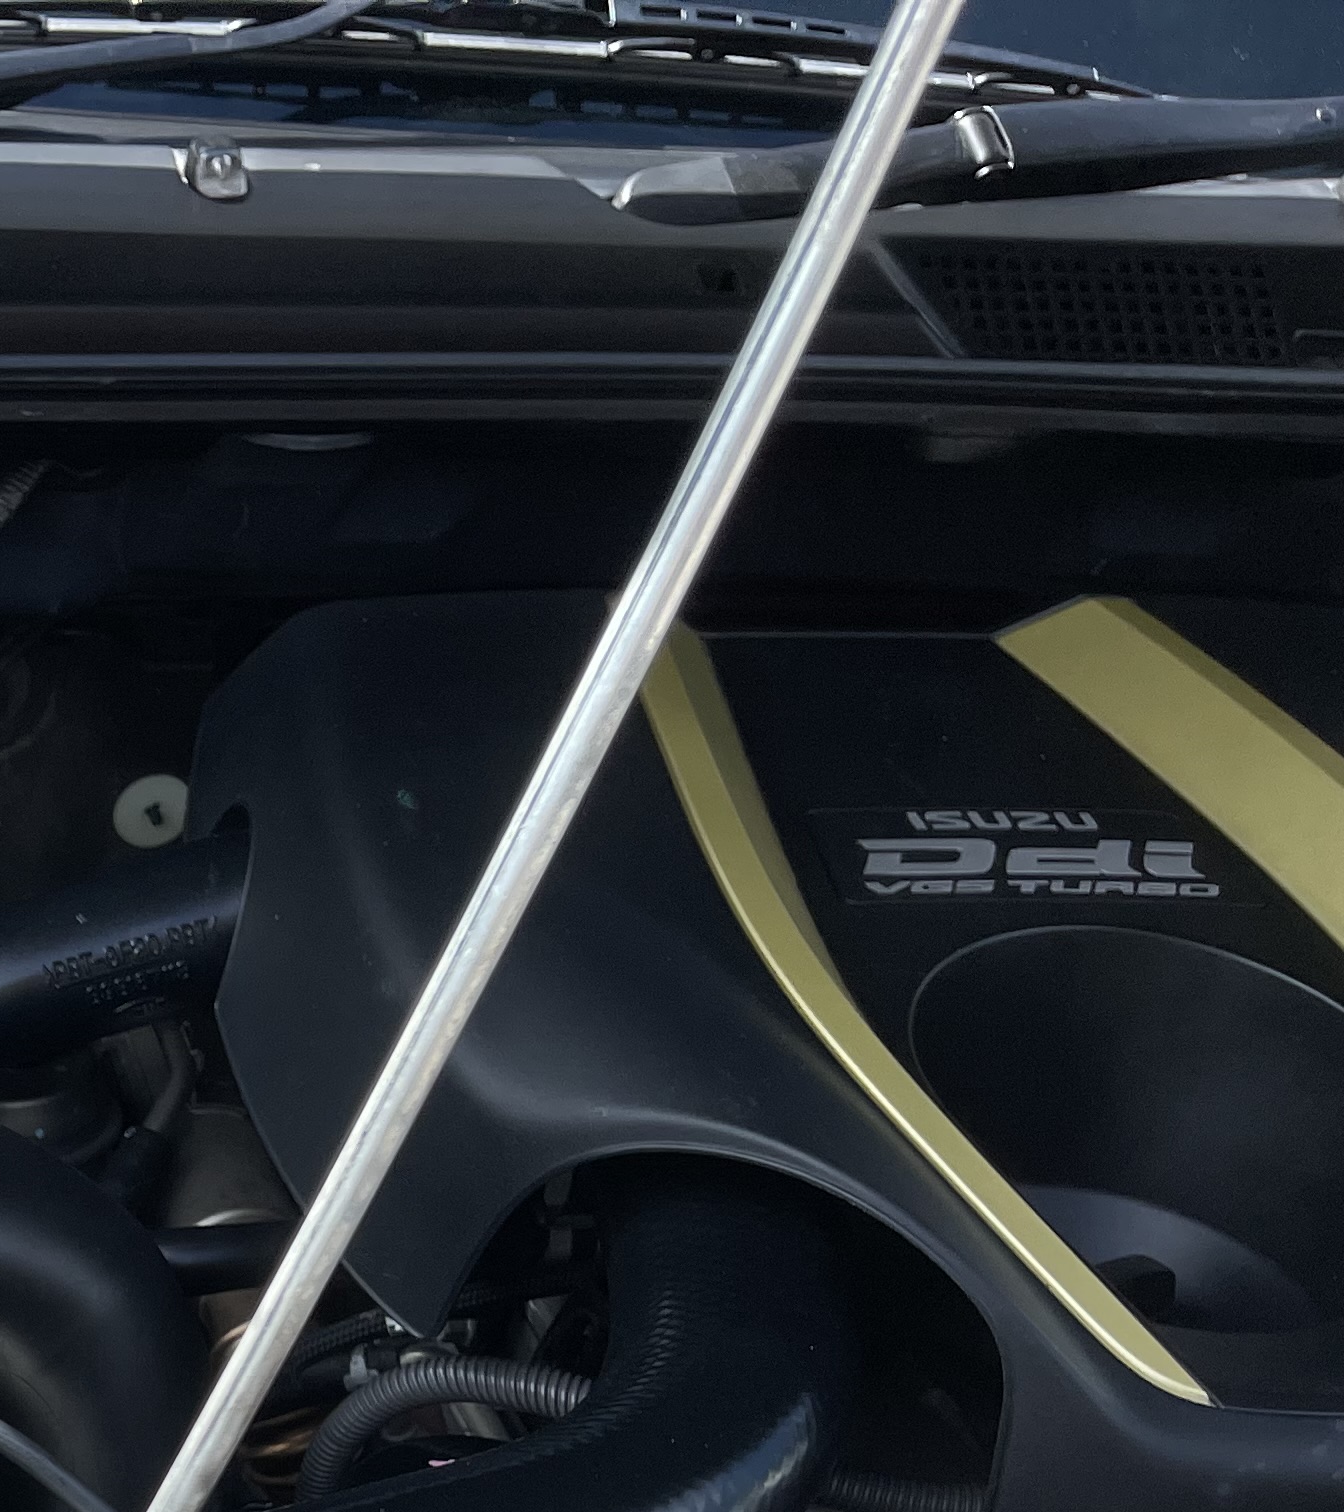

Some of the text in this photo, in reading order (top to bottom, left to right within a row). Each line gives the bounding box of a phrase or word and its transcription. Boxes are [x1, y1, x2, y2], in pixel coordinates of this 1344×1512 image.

[906, 810, 1099, 832] ISUZU
[864, 879, 1221, 898] VGS TURBO
